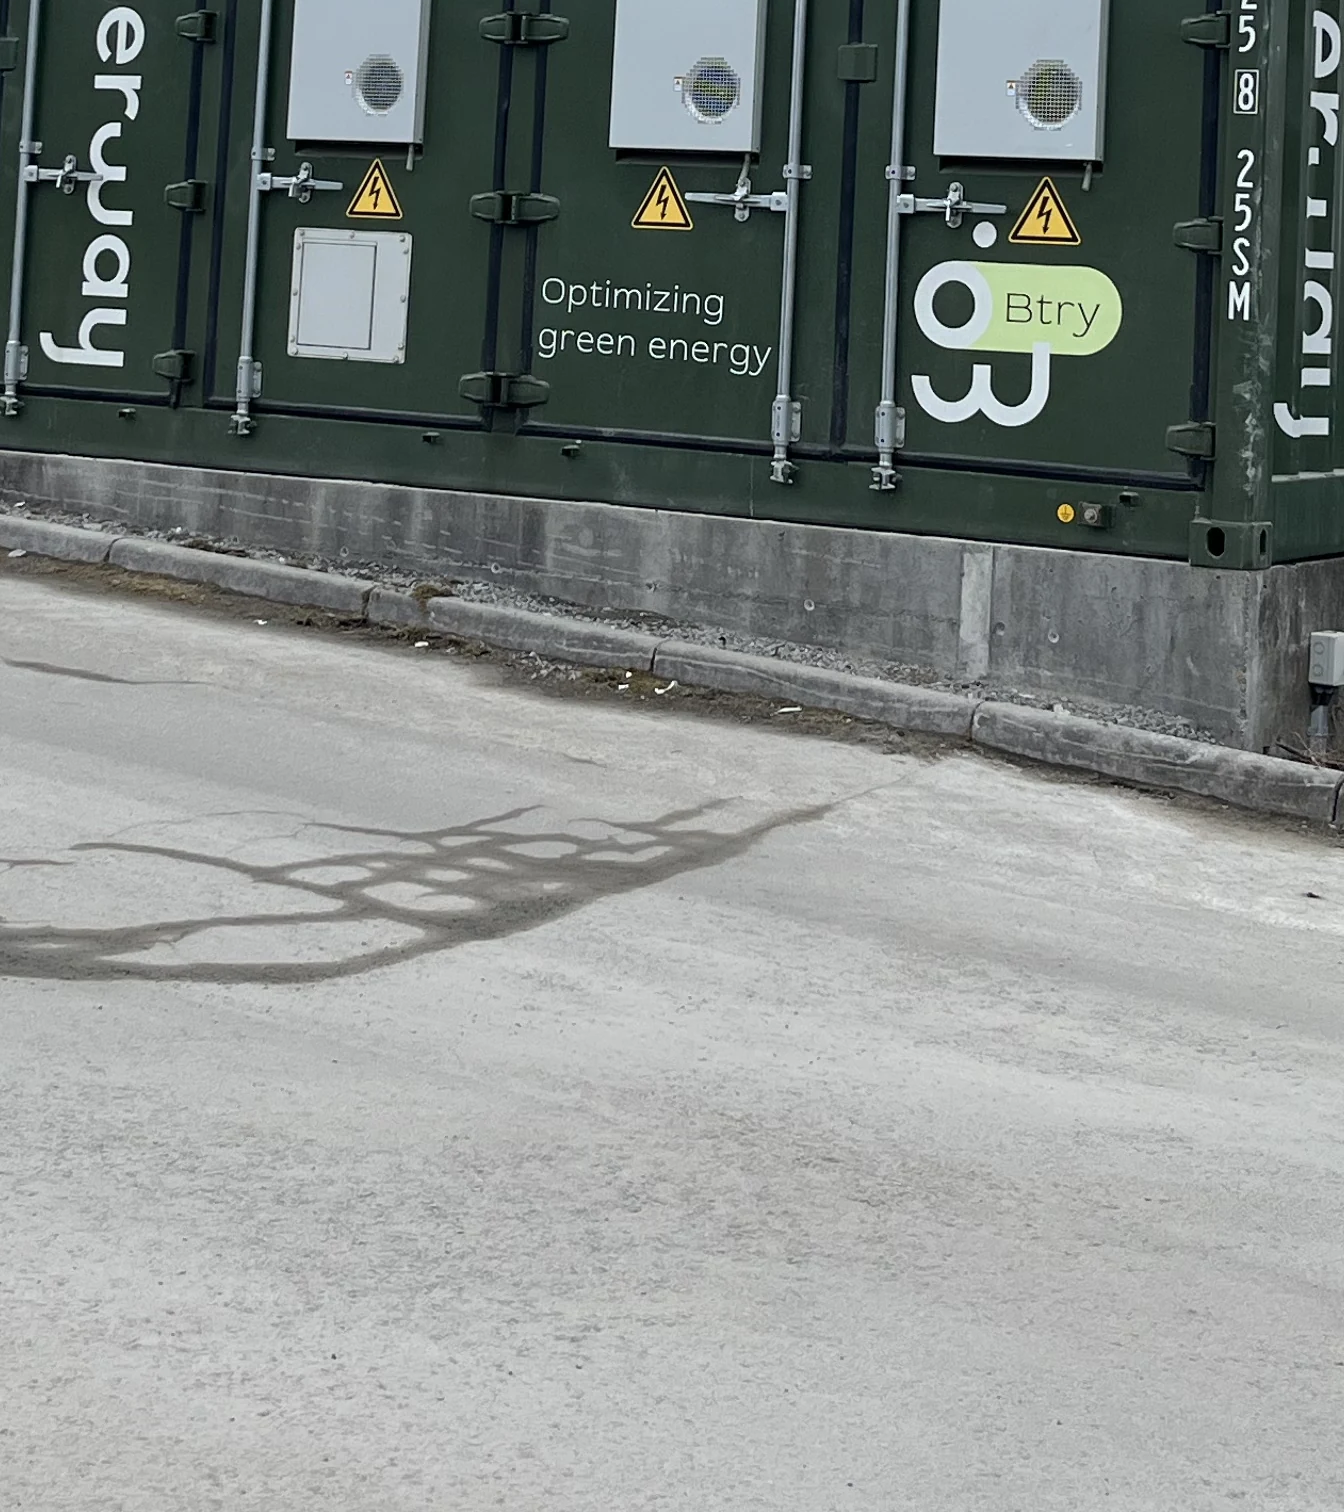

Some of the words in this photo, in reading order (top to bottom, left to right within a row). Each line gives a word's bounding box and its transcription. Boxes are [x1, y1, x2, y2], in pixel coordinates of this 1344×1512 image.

[1238, 73, 1254, 111] 8
[1228, 149, 1256, 321] 25SM
[542, 277, 724, 325] Optimizing
[1006, 293, 1100, 338] Btry
[538, 327, 636, 359] green
[648, 337, 772, 376] energy
